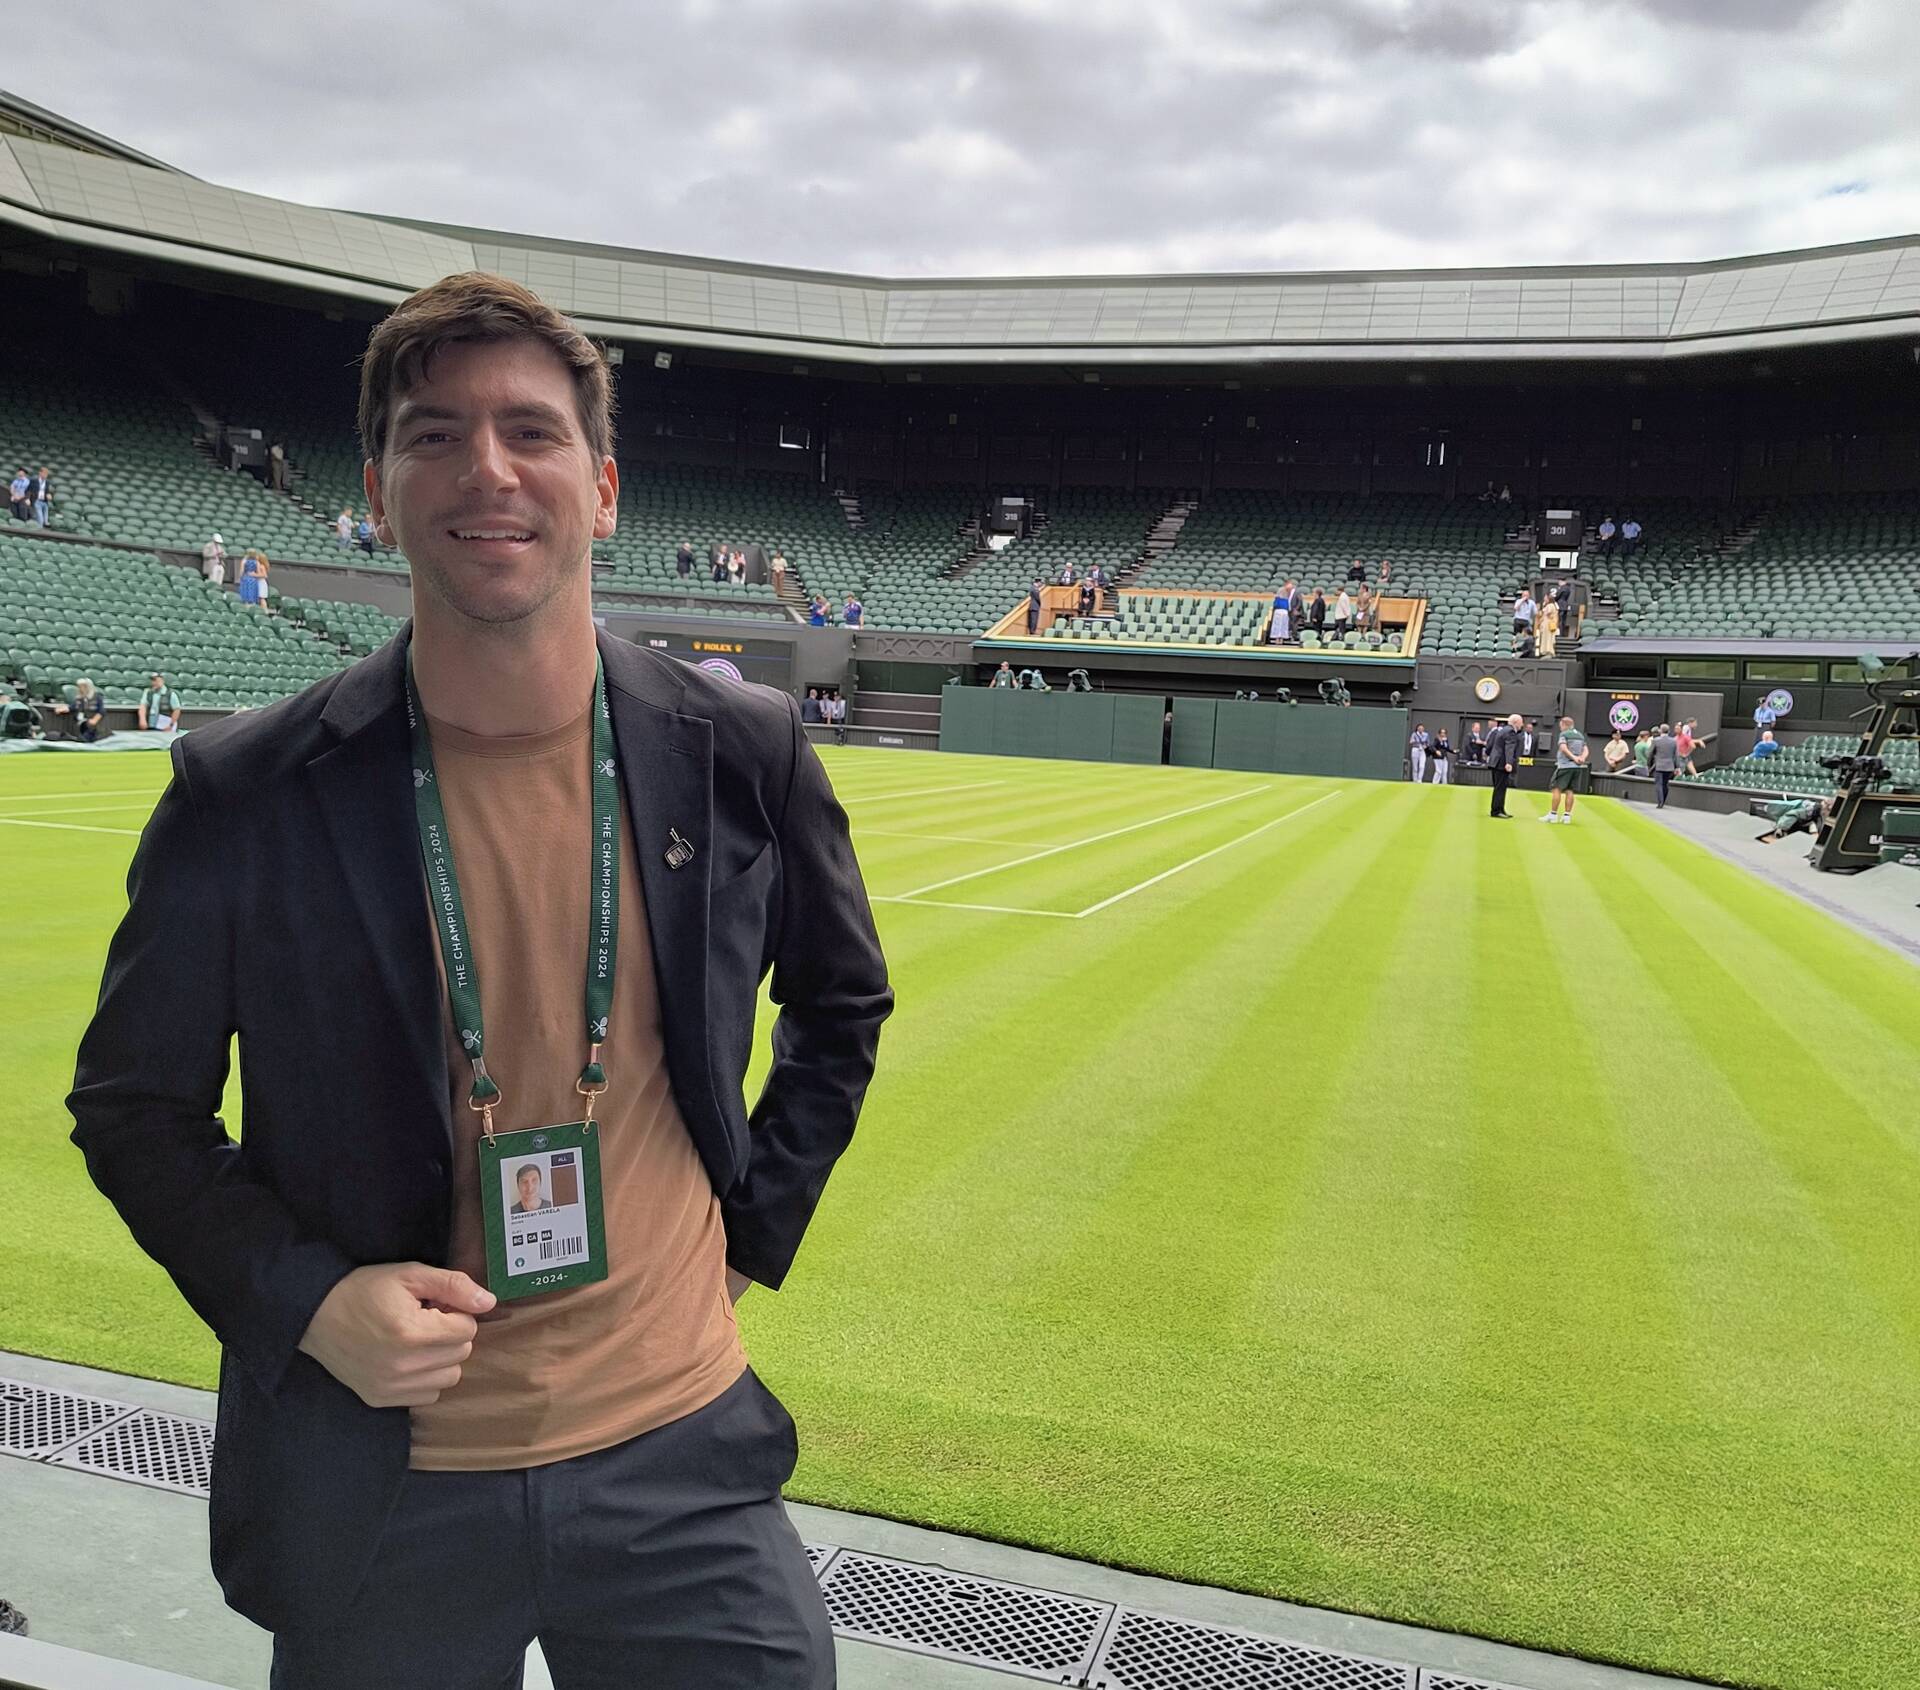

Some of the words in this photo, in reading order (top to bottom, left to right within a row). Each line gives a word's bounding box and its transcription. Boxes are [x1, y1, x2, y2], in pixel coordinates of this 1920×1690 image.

[1550, 526, 1566, 535] 301
[429, 824, 443, 854] 2024
[602, 815, 612, 838] THE
[600, 842, 612, 944] CHAMPIONSHIPS
[435, 857, 463, 960] CHAMPIONSHIPS
[455, 963, 468, 988] THE
[597, 948, 608, 978] 2024
[538, 1208, 560, 1216] VARELA
